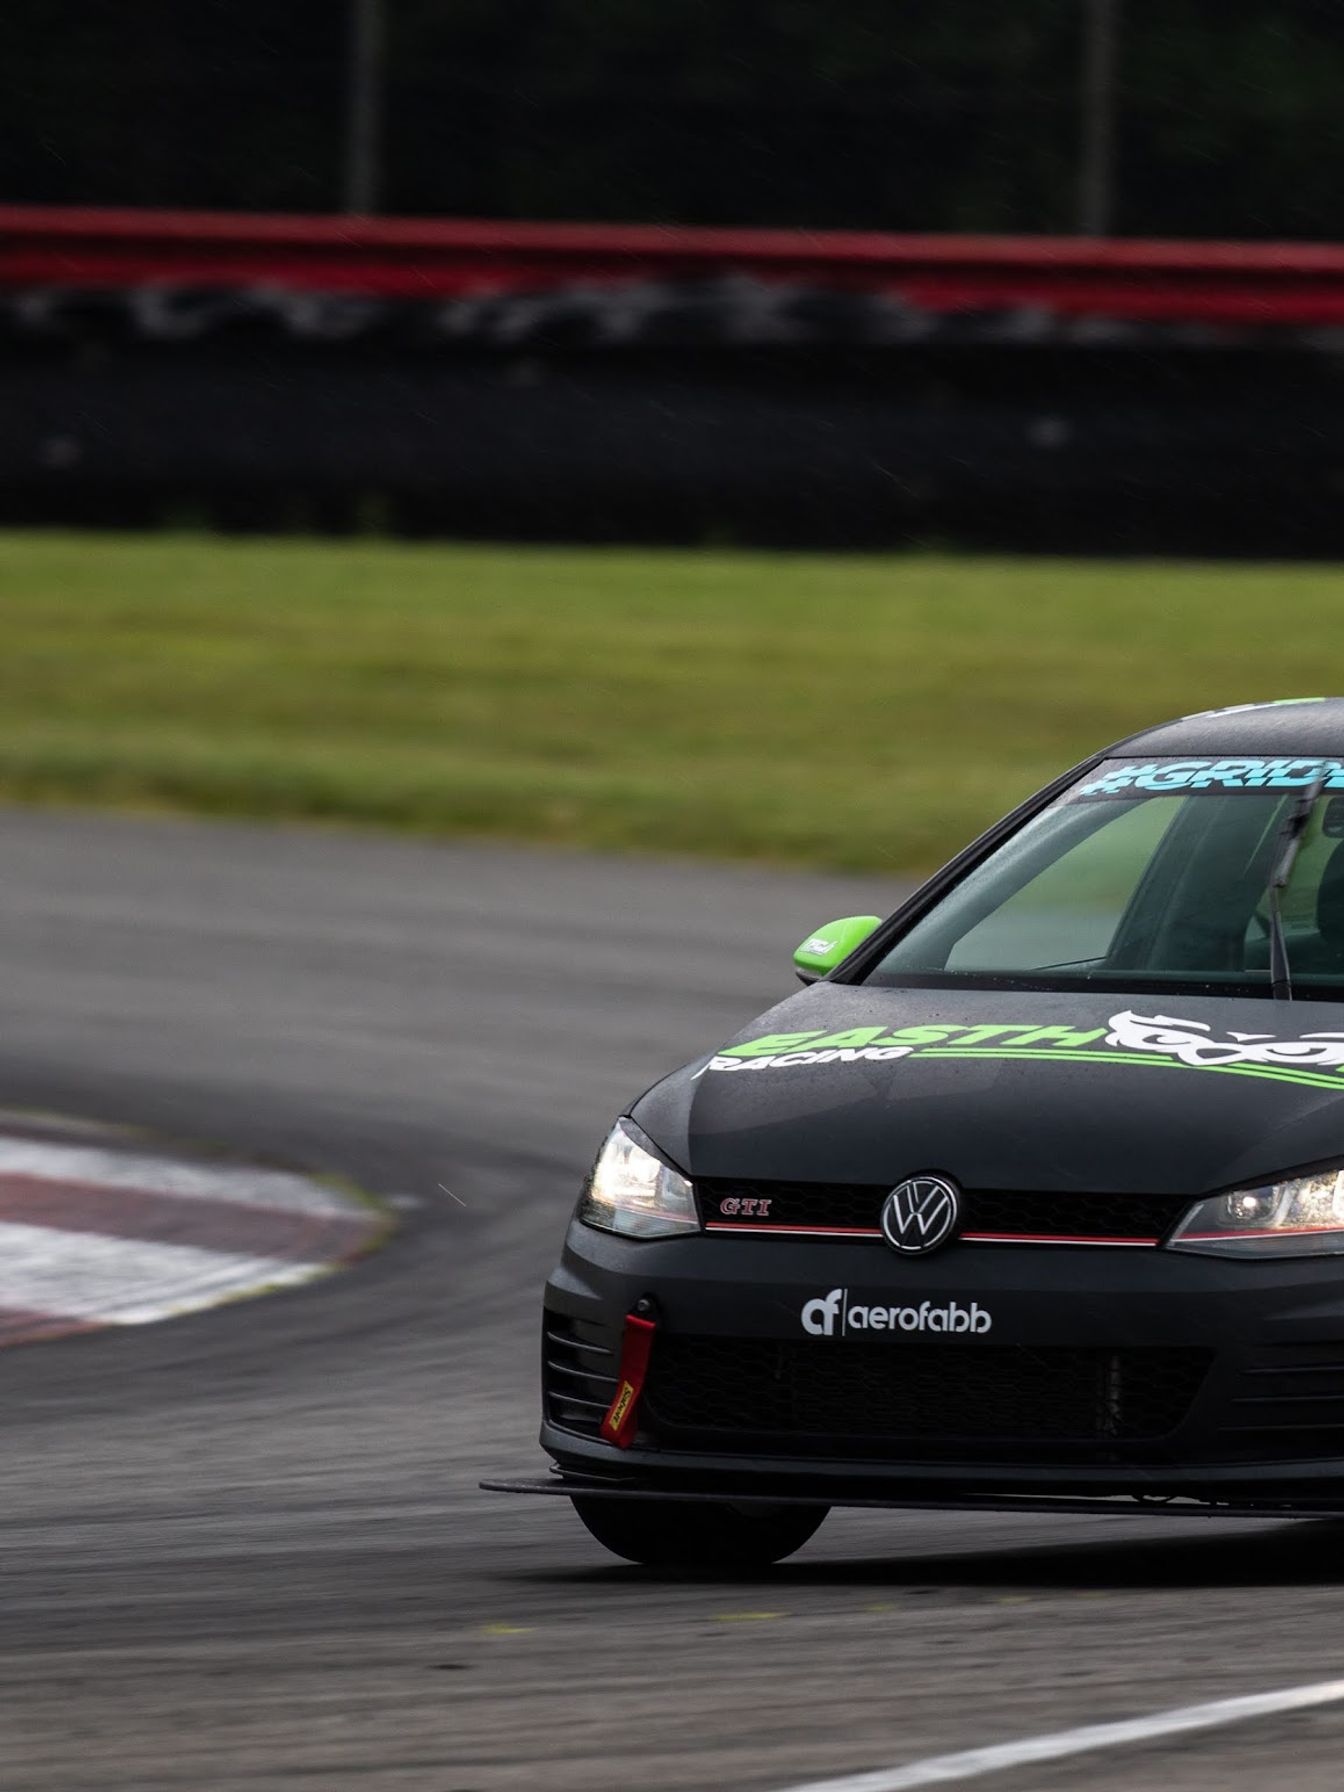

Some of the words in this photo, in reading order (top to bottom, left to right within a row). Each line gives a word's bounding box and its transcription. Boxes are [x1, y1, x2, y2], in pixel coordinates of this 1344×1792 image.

[690, 1046, 914, 1081] RACING
[719, 1198, 772, 1216] GTI
[847, 1301, 992, 1334] aerofabb
